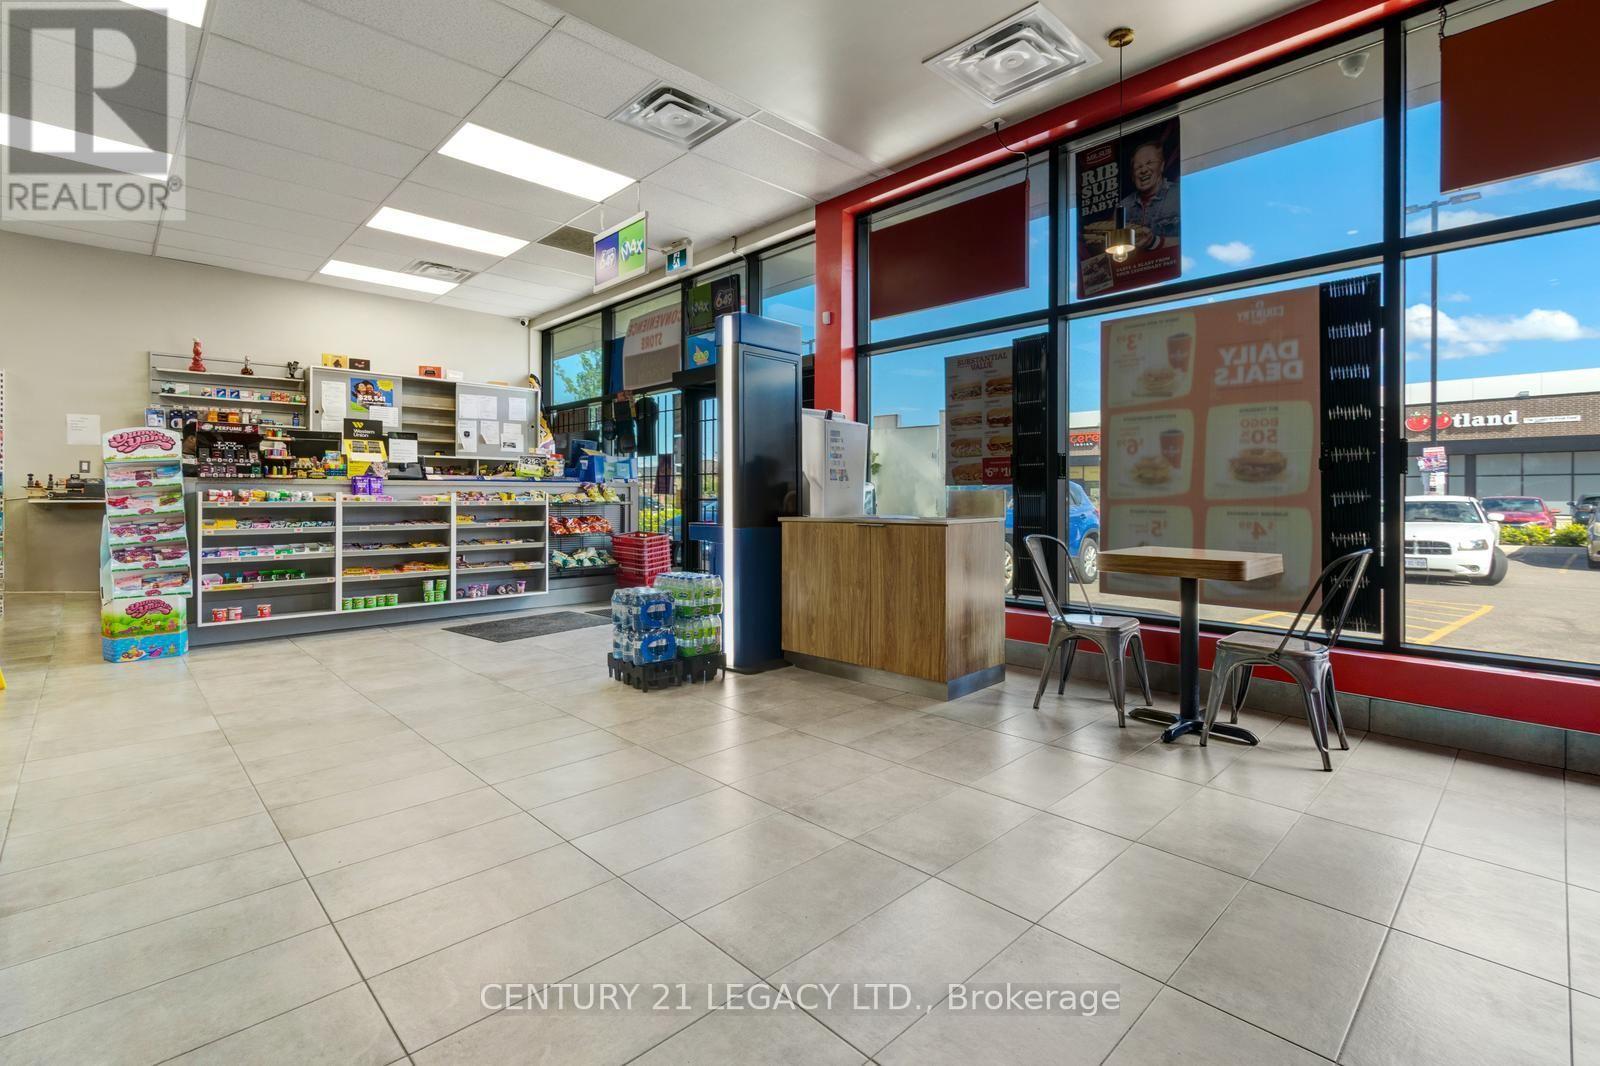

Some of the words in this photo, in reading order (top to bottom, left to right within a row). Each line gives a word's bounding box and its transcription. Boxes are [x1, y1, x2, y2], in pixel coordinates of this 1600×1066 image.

[1081, 162, 1119, 187] RIB
[1081, 177, 1119, 200] SUB
[1082, 199, 1091, 207] IS
[1093, 190, 1119, 203] BACK
[1081, 197, 1119, 217] BABY!
[621, 238, 644, 262] MAX
[957, 351, 1008, 366] SUBSTANTIAL
